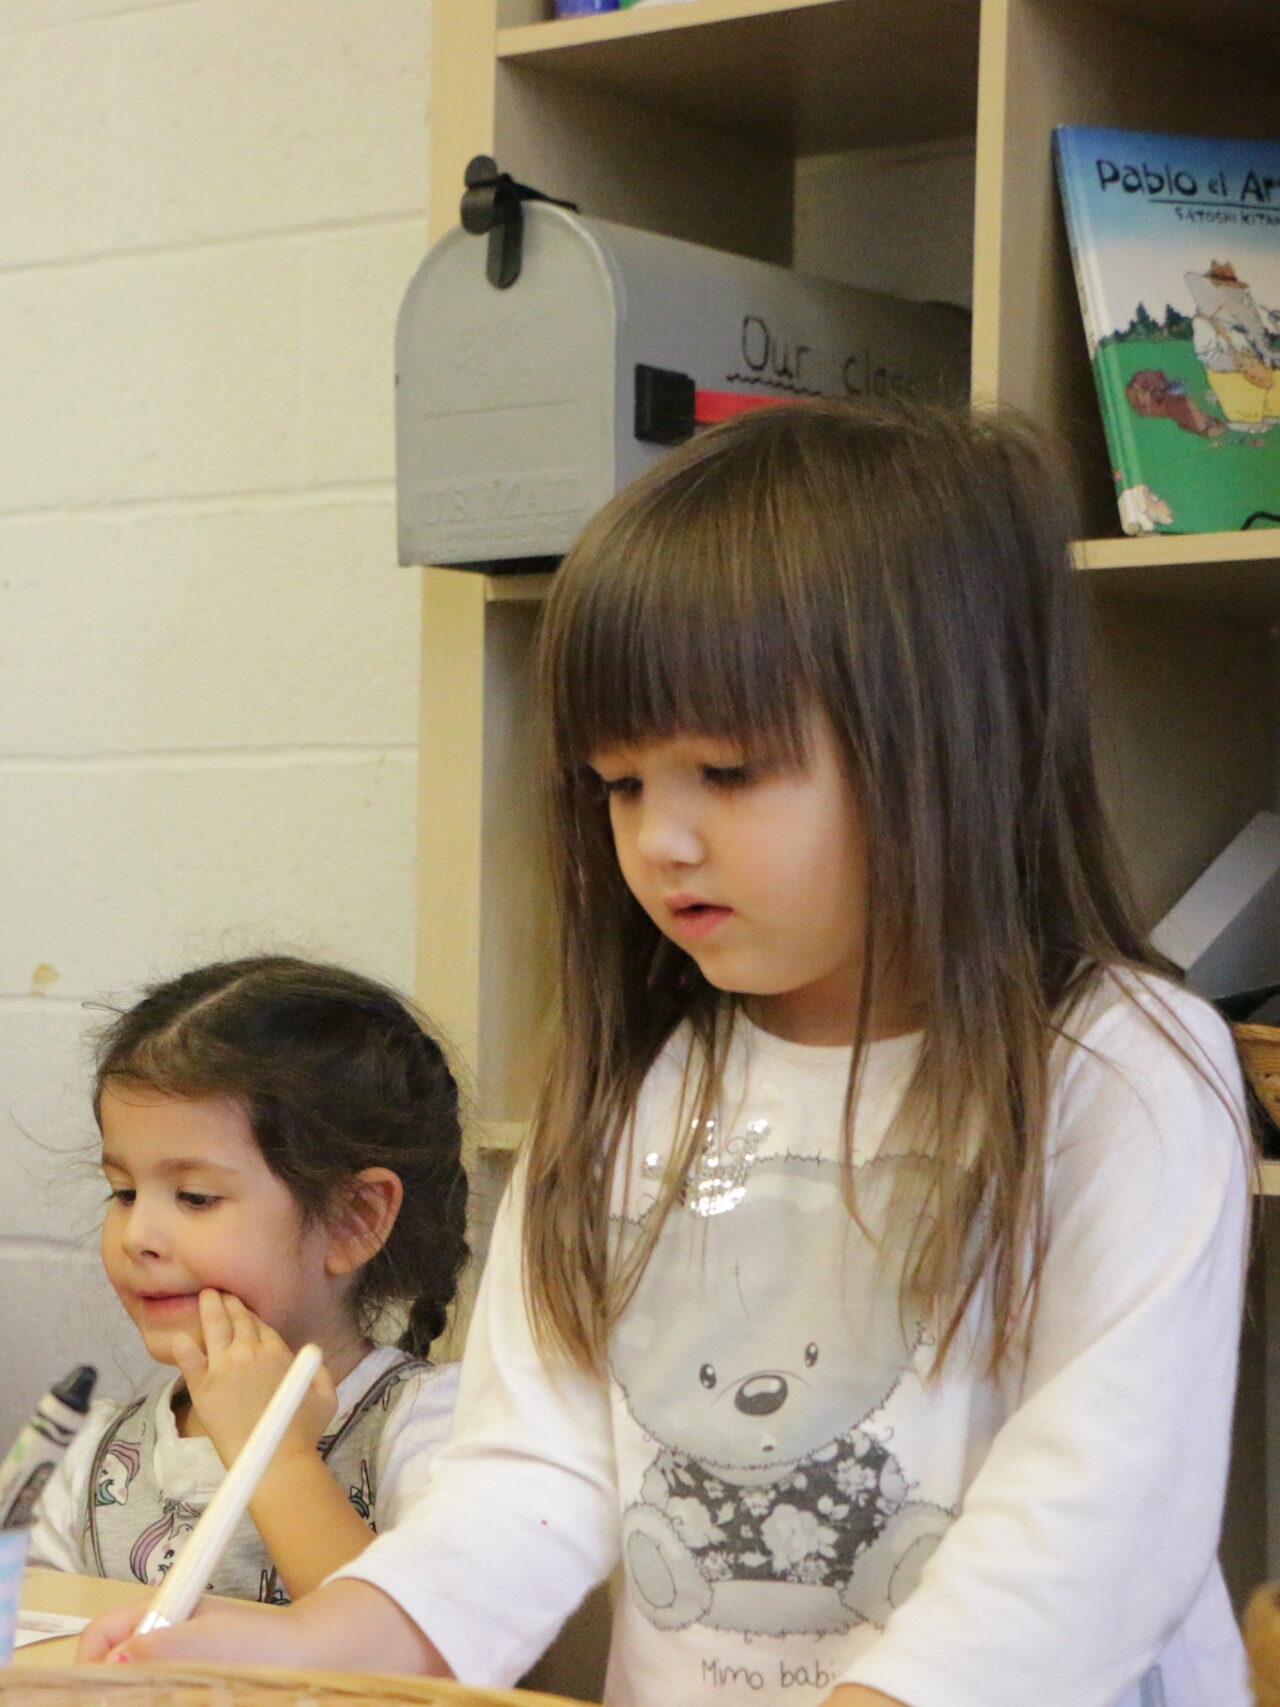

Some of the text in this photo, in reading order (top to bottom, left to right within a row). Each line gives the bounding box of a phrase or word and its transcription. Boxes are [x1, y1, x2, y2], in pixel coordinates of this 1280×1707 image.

[1096, 160, 1280, 202] Pablo el Ar
[1175, 207, 1238, 224] SATOSHI
[742, 315, 809, 378] Our
